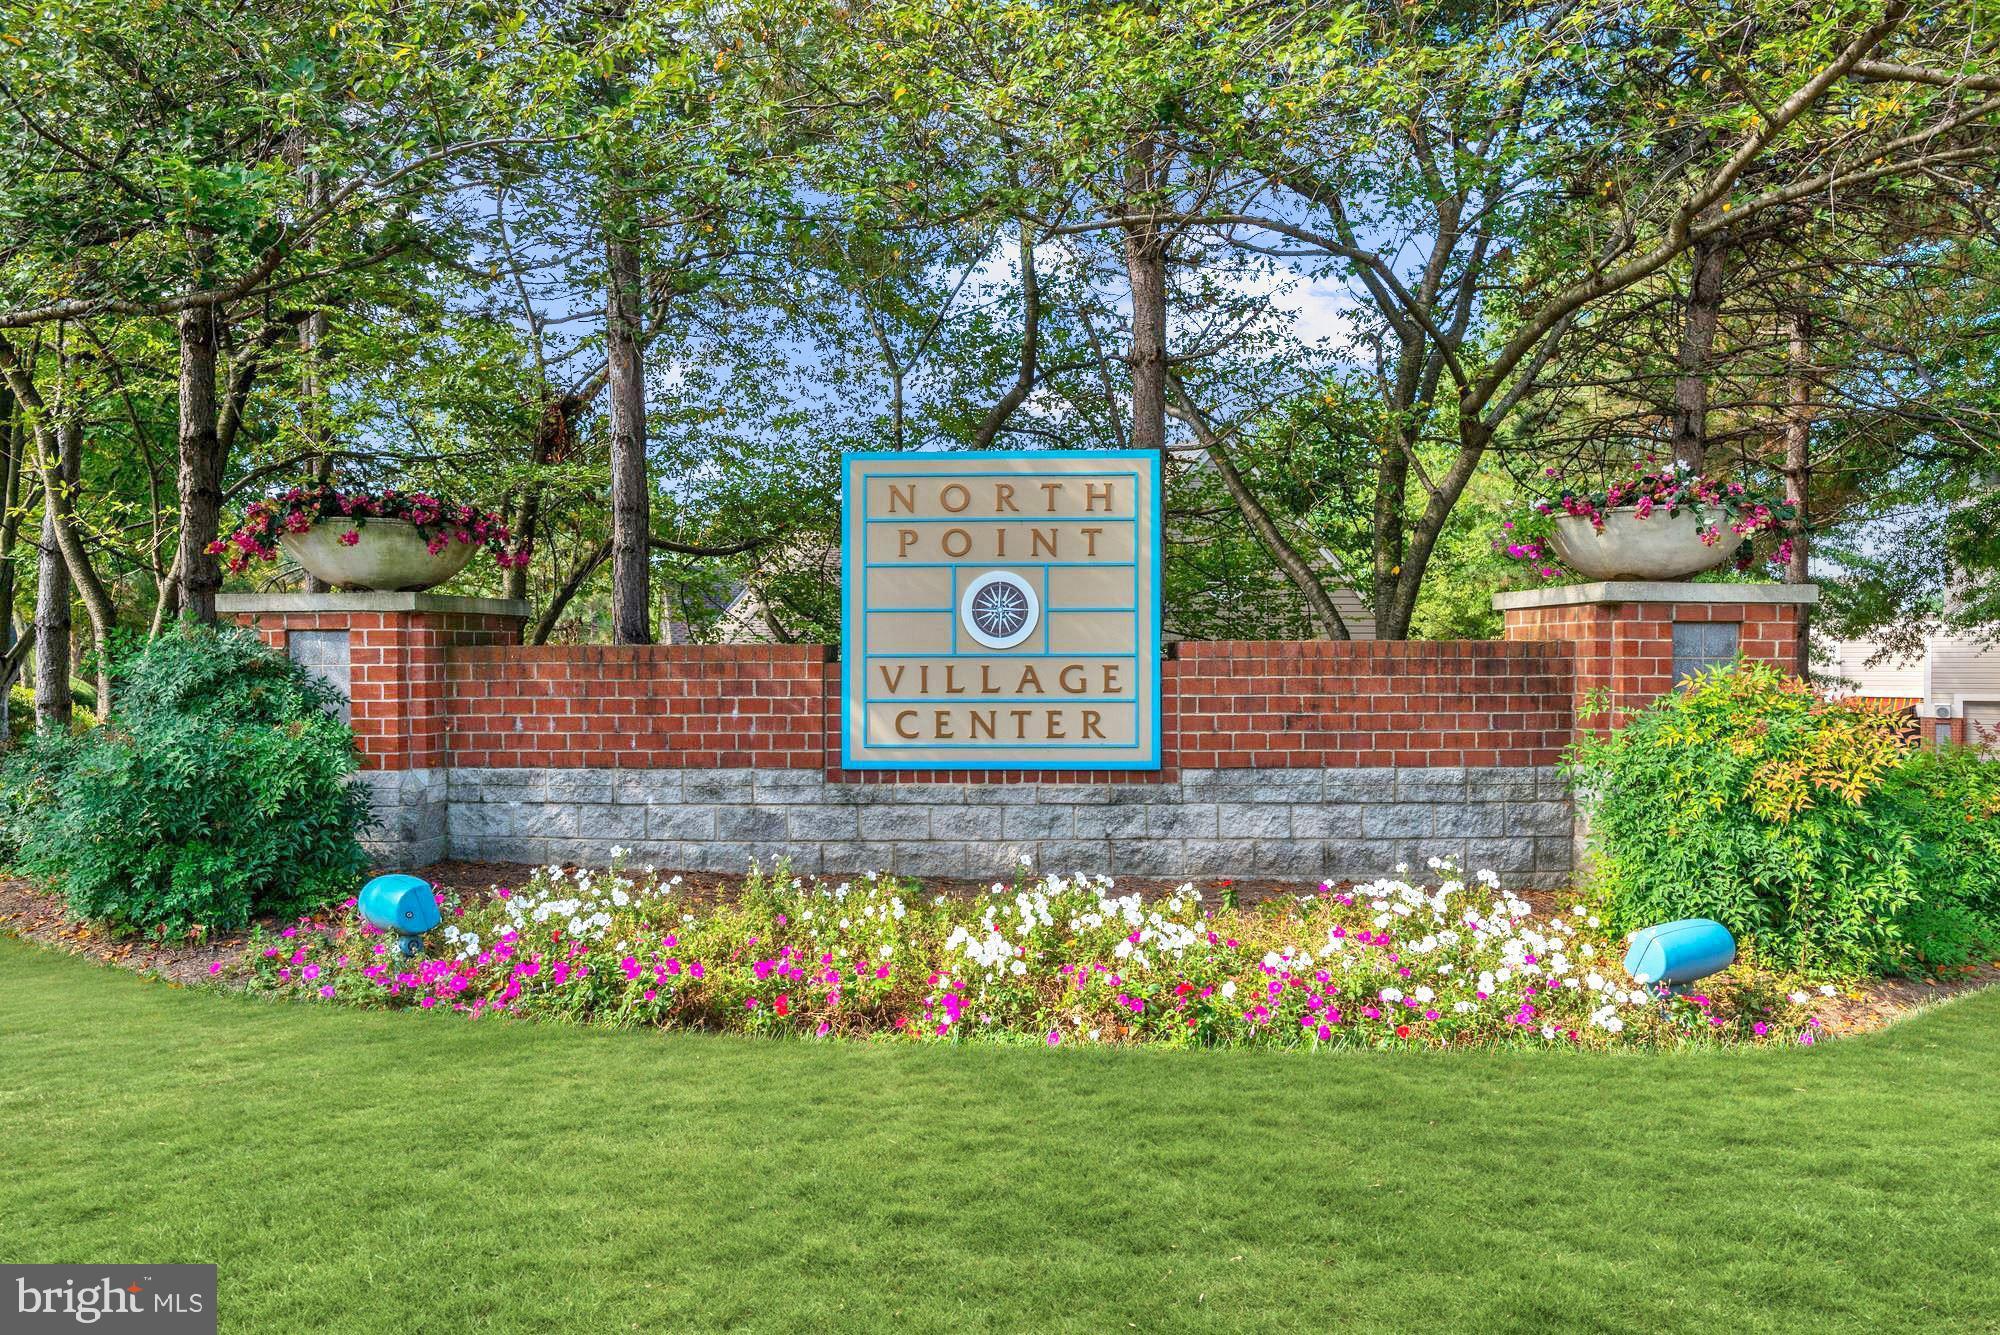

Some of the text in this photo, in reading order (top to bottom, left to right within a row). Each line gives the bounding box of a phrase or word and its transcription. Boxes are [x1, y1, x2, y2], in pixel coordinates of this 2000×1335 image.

[888, 483, 1113, 513] NORTH
[897, 528, 1102, 557] POINT
[880, 665, 1122, 693] VILLAGE
[895, 710, 1106, 738] CENTER
